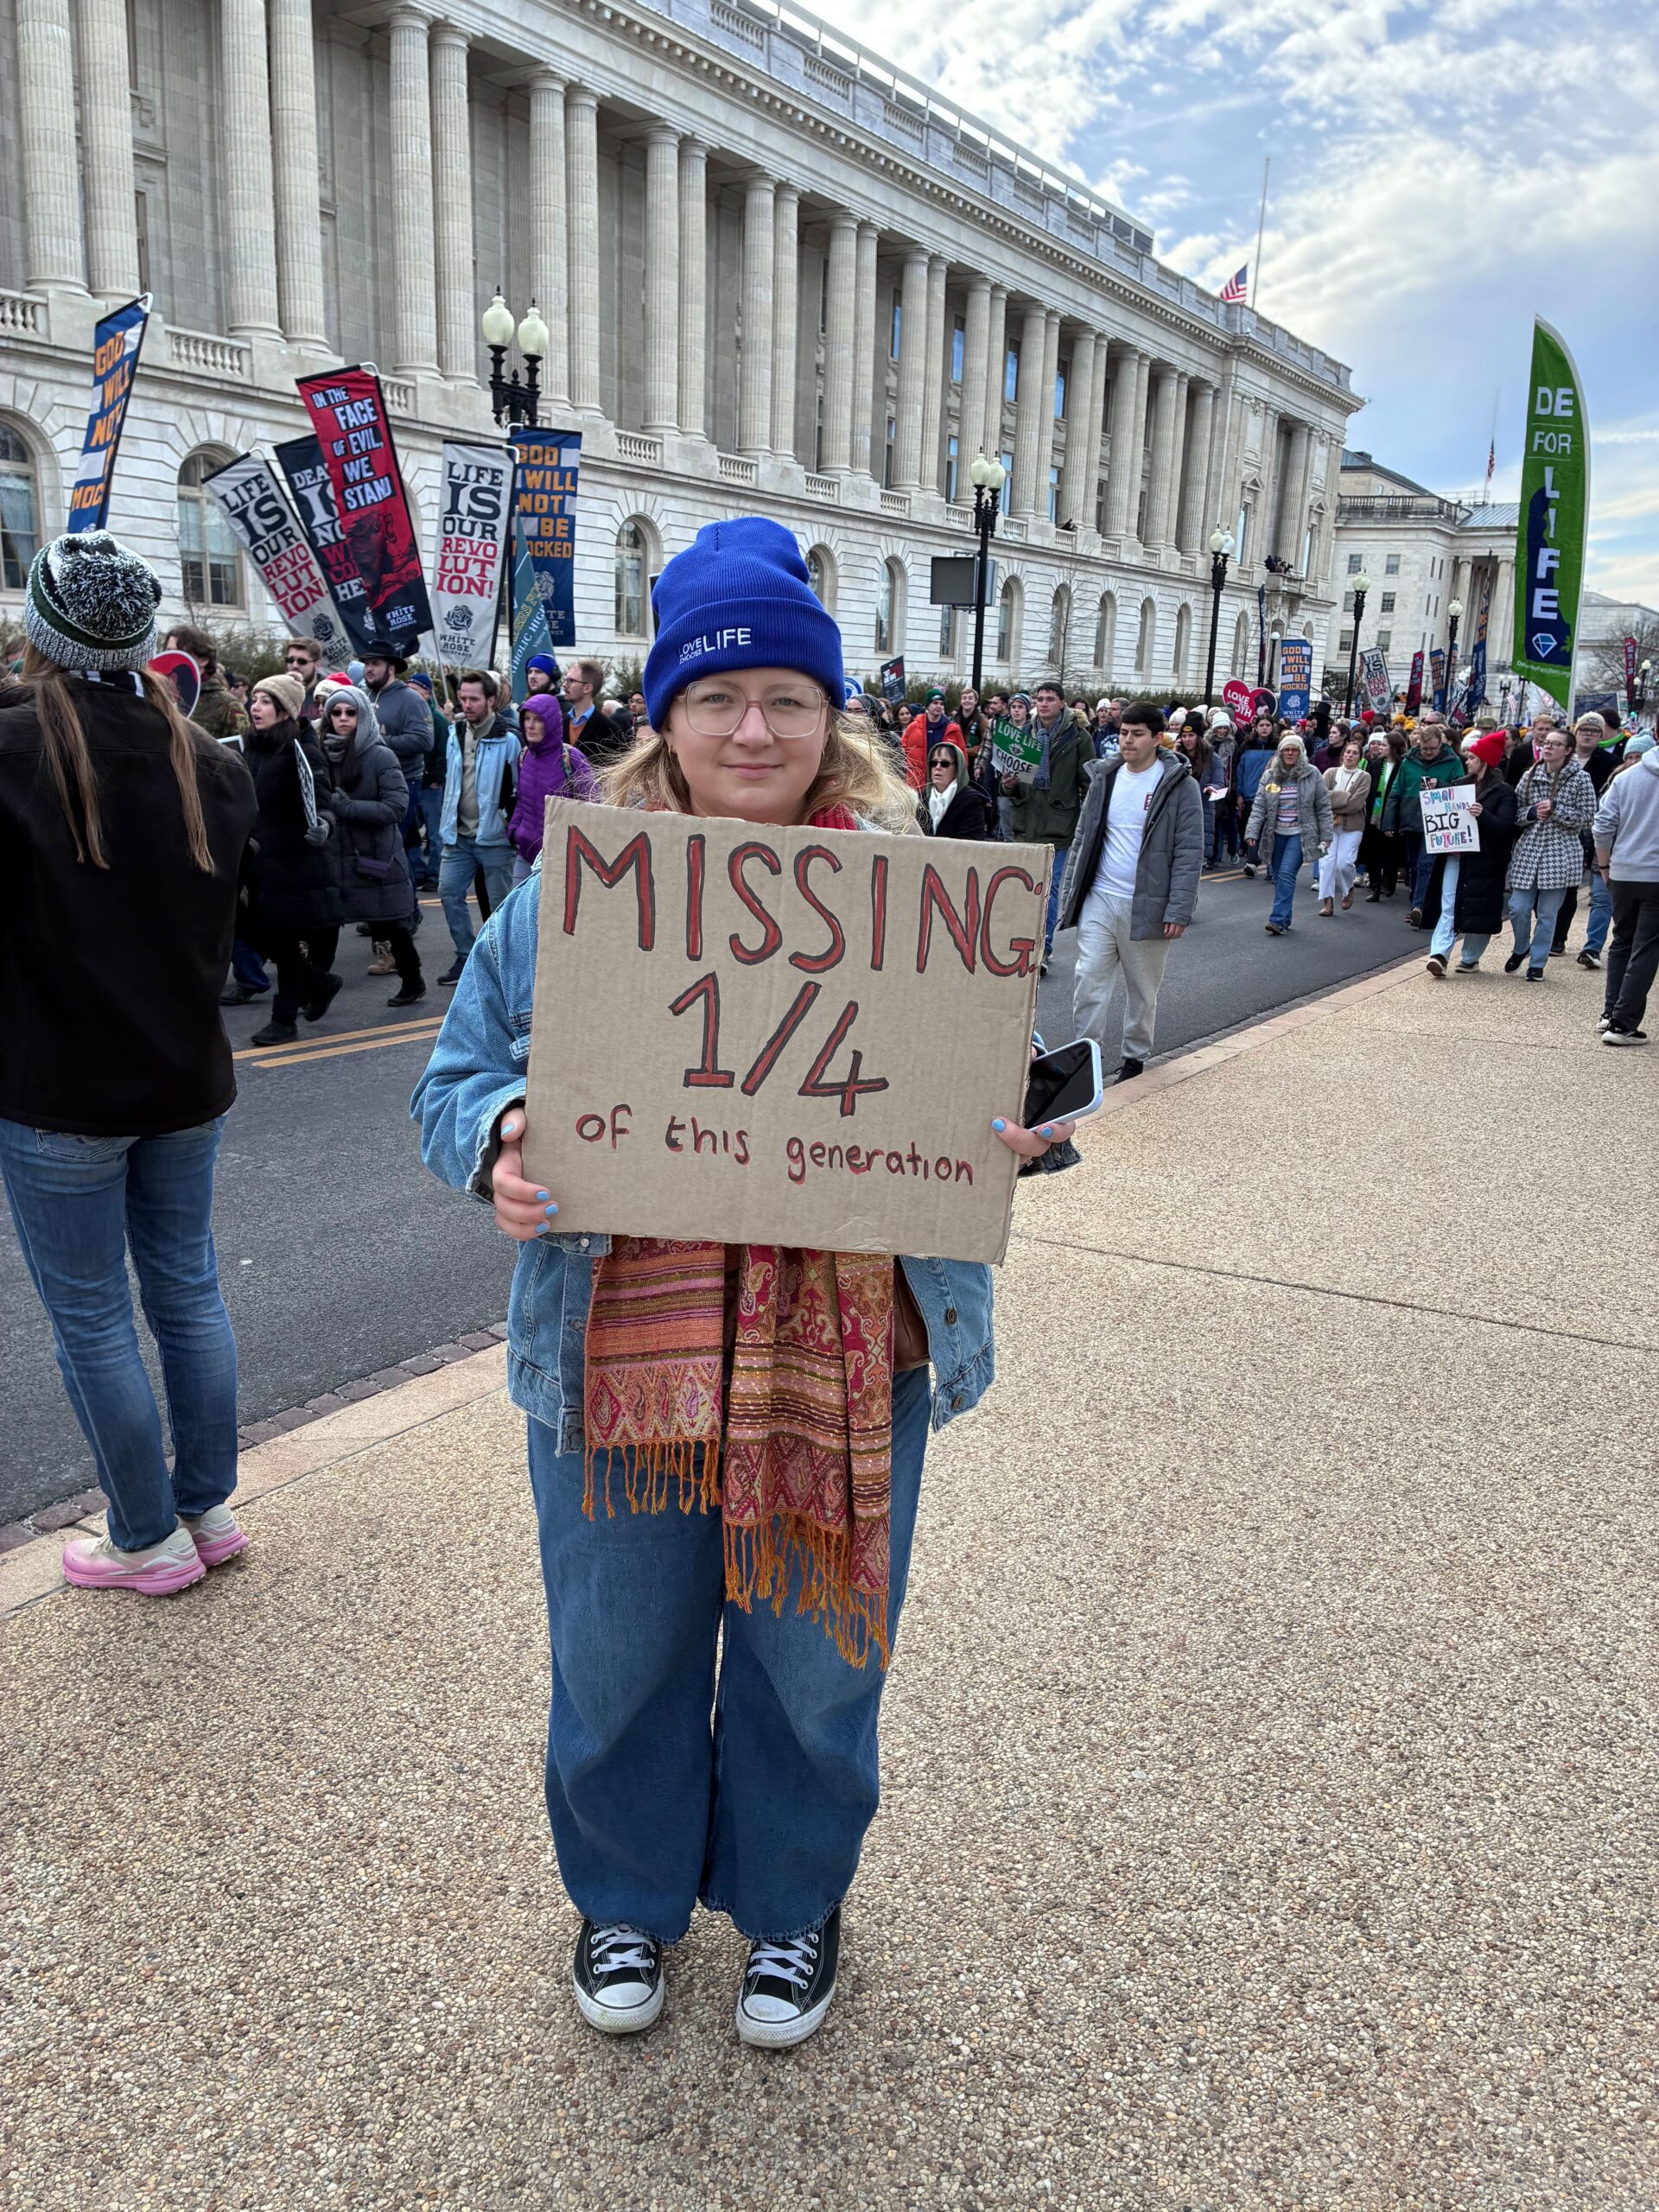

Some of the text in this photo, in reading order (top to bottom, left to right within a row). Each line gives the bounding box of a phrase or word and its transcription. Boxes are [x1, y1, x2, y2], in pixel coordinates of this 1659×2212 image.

[95, 331, 124, 377] GOD
[103, 359, 130, 410] WILL
[311, 386, 349, 409] IN THE
[1535, 385, 1573, 417] DE
[334, 397, 378, 431] FACE
[332, 427, 384, 457] OF EVIL,
[1533, 430, 1572, 455] FOR
[513, 443, 558, 467] GOD
[290, 463, 332, 489] DEA
[343, 456, 374, 484] WE
[447, 461, 503, 487] LIFE
[524, 468, 576, 492] WILL
[219, 472, 270, 513] LIFE
[443, 480, 502, 521] IS
[518, 493, 563, 515] NOT
[231, 493, 288, 548] IS
[442, 516, 499, 542] OUR
[539, 517, 569, 538] BE
[252, 526, 302, 565] OUR
[311, 523, 347, 548] NO
[1532, 466, 1560, 620] LIFE
[440, 537, 499, 560] REVO
[262, 543, 309, 583] REVO
[438, 553, 495, 579] LUT
[268, 561, 319, 601] LUT
[435, 571, 494, 600] ION!
[279, 577, 329, 620] ION!
[389, 613, 413, 626] ROSE
[439, 633, 475, 646] WHITE
[442, 642, 470, 652] ROSE
[678, 637, 702, 658] LOVE
[702, 627, 752, 652] LIFE
[1282, 646, 1301, 655] GOD
[679, 647, 702, 664] CHOOSE
[1287, 655, 1310, 664] WILL
[1365, 659, 1383, 673] IS
[1284, 664, 1305, 674] NOT
[1294, 674, 1307, 683] BE
[1227, 689, 1250, 705] LOVE
[1234, 703, 1252, 718] OTH
[998, 721, 1043, 752] LOVE LIFE
[996, 748, 1033, 773] CHOOSE
[1002, 765, 1020, 778] LFE
[1444, 802, 1471, 813] HANDS
[1425, 812, 1460, 834] BIG
[668, 970, 889, 1117] 1/4
[575, 1103, 974, 1185] of this generation
